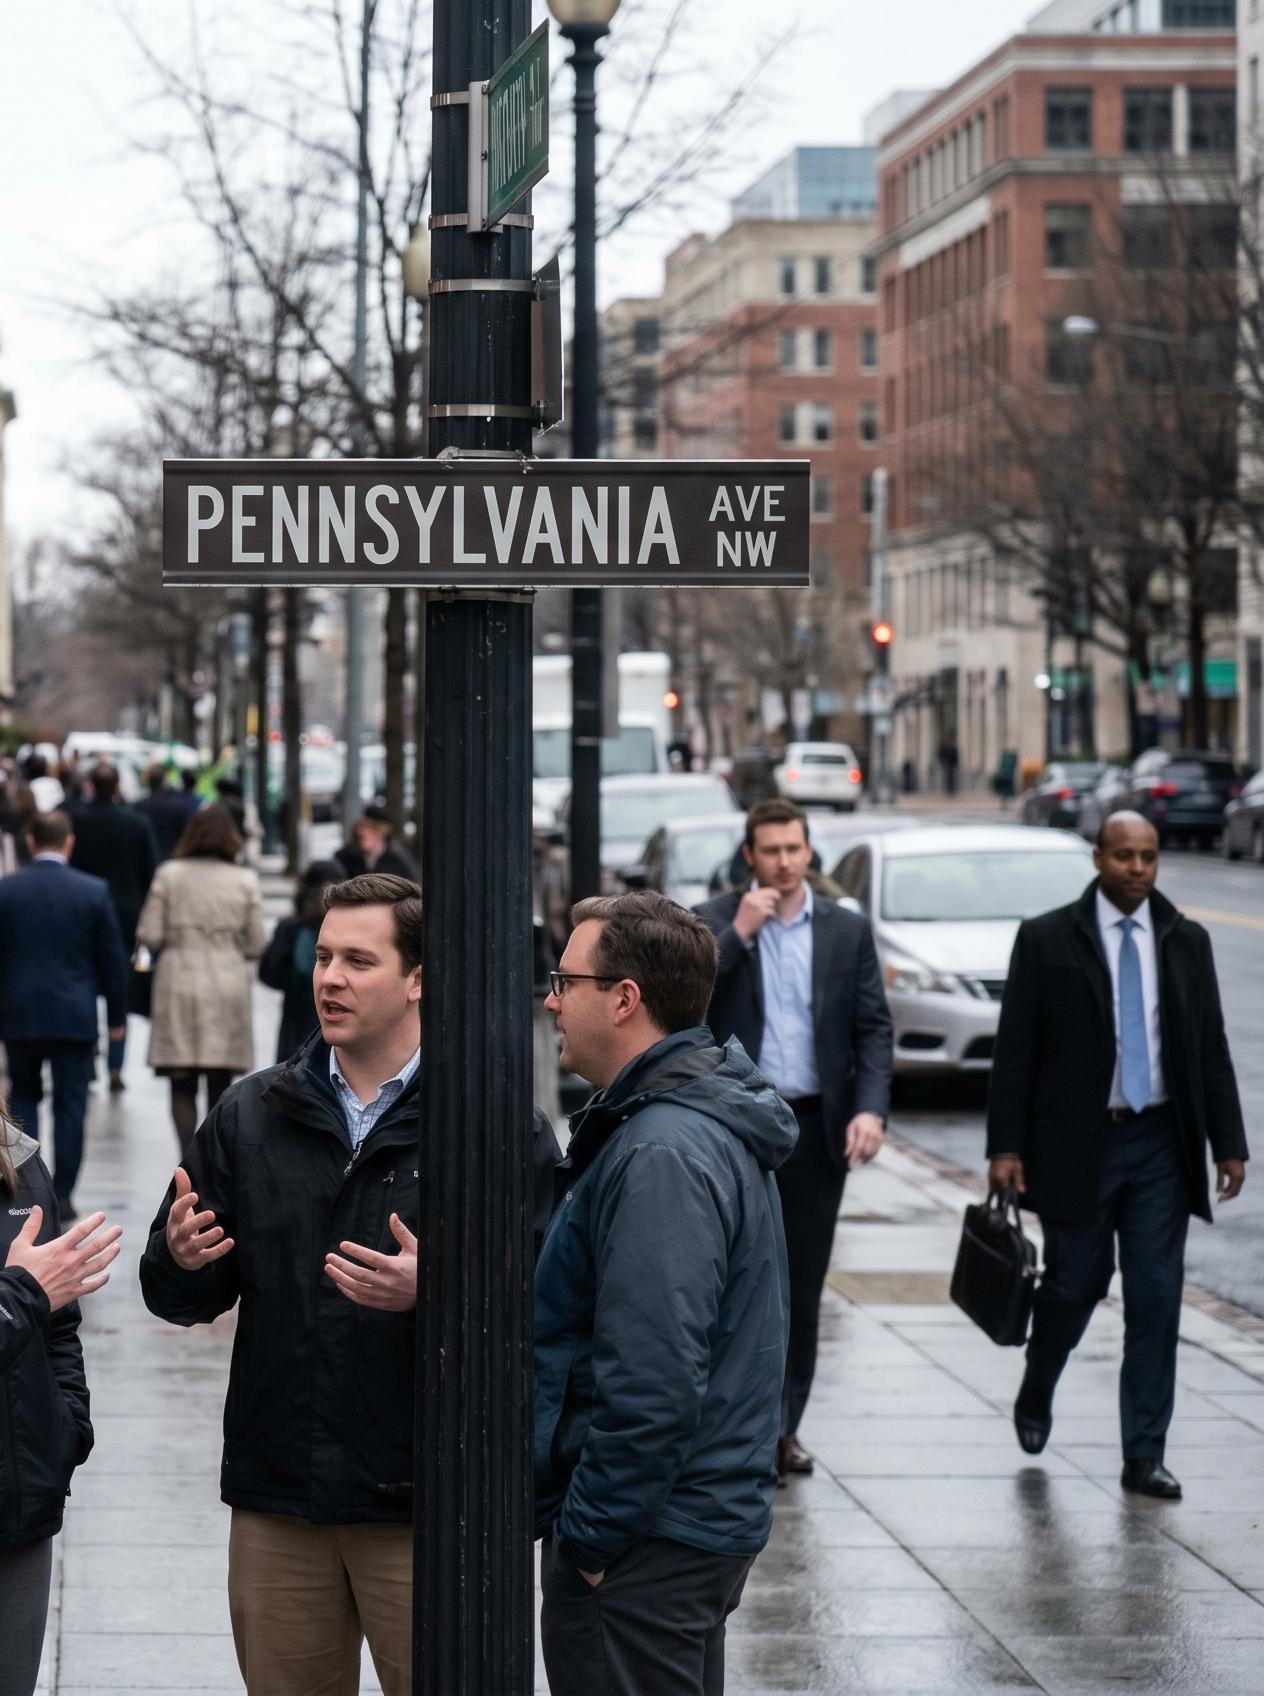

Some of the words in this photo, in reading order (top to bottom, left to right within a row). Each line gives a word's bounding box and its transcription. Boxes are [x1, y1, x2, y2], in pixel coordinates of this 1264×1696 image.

[187, 485, 681, 565] PENNSYLVANIA
[709, 485, 786, 522] AVE
[716, 531, 777, 567] NW
